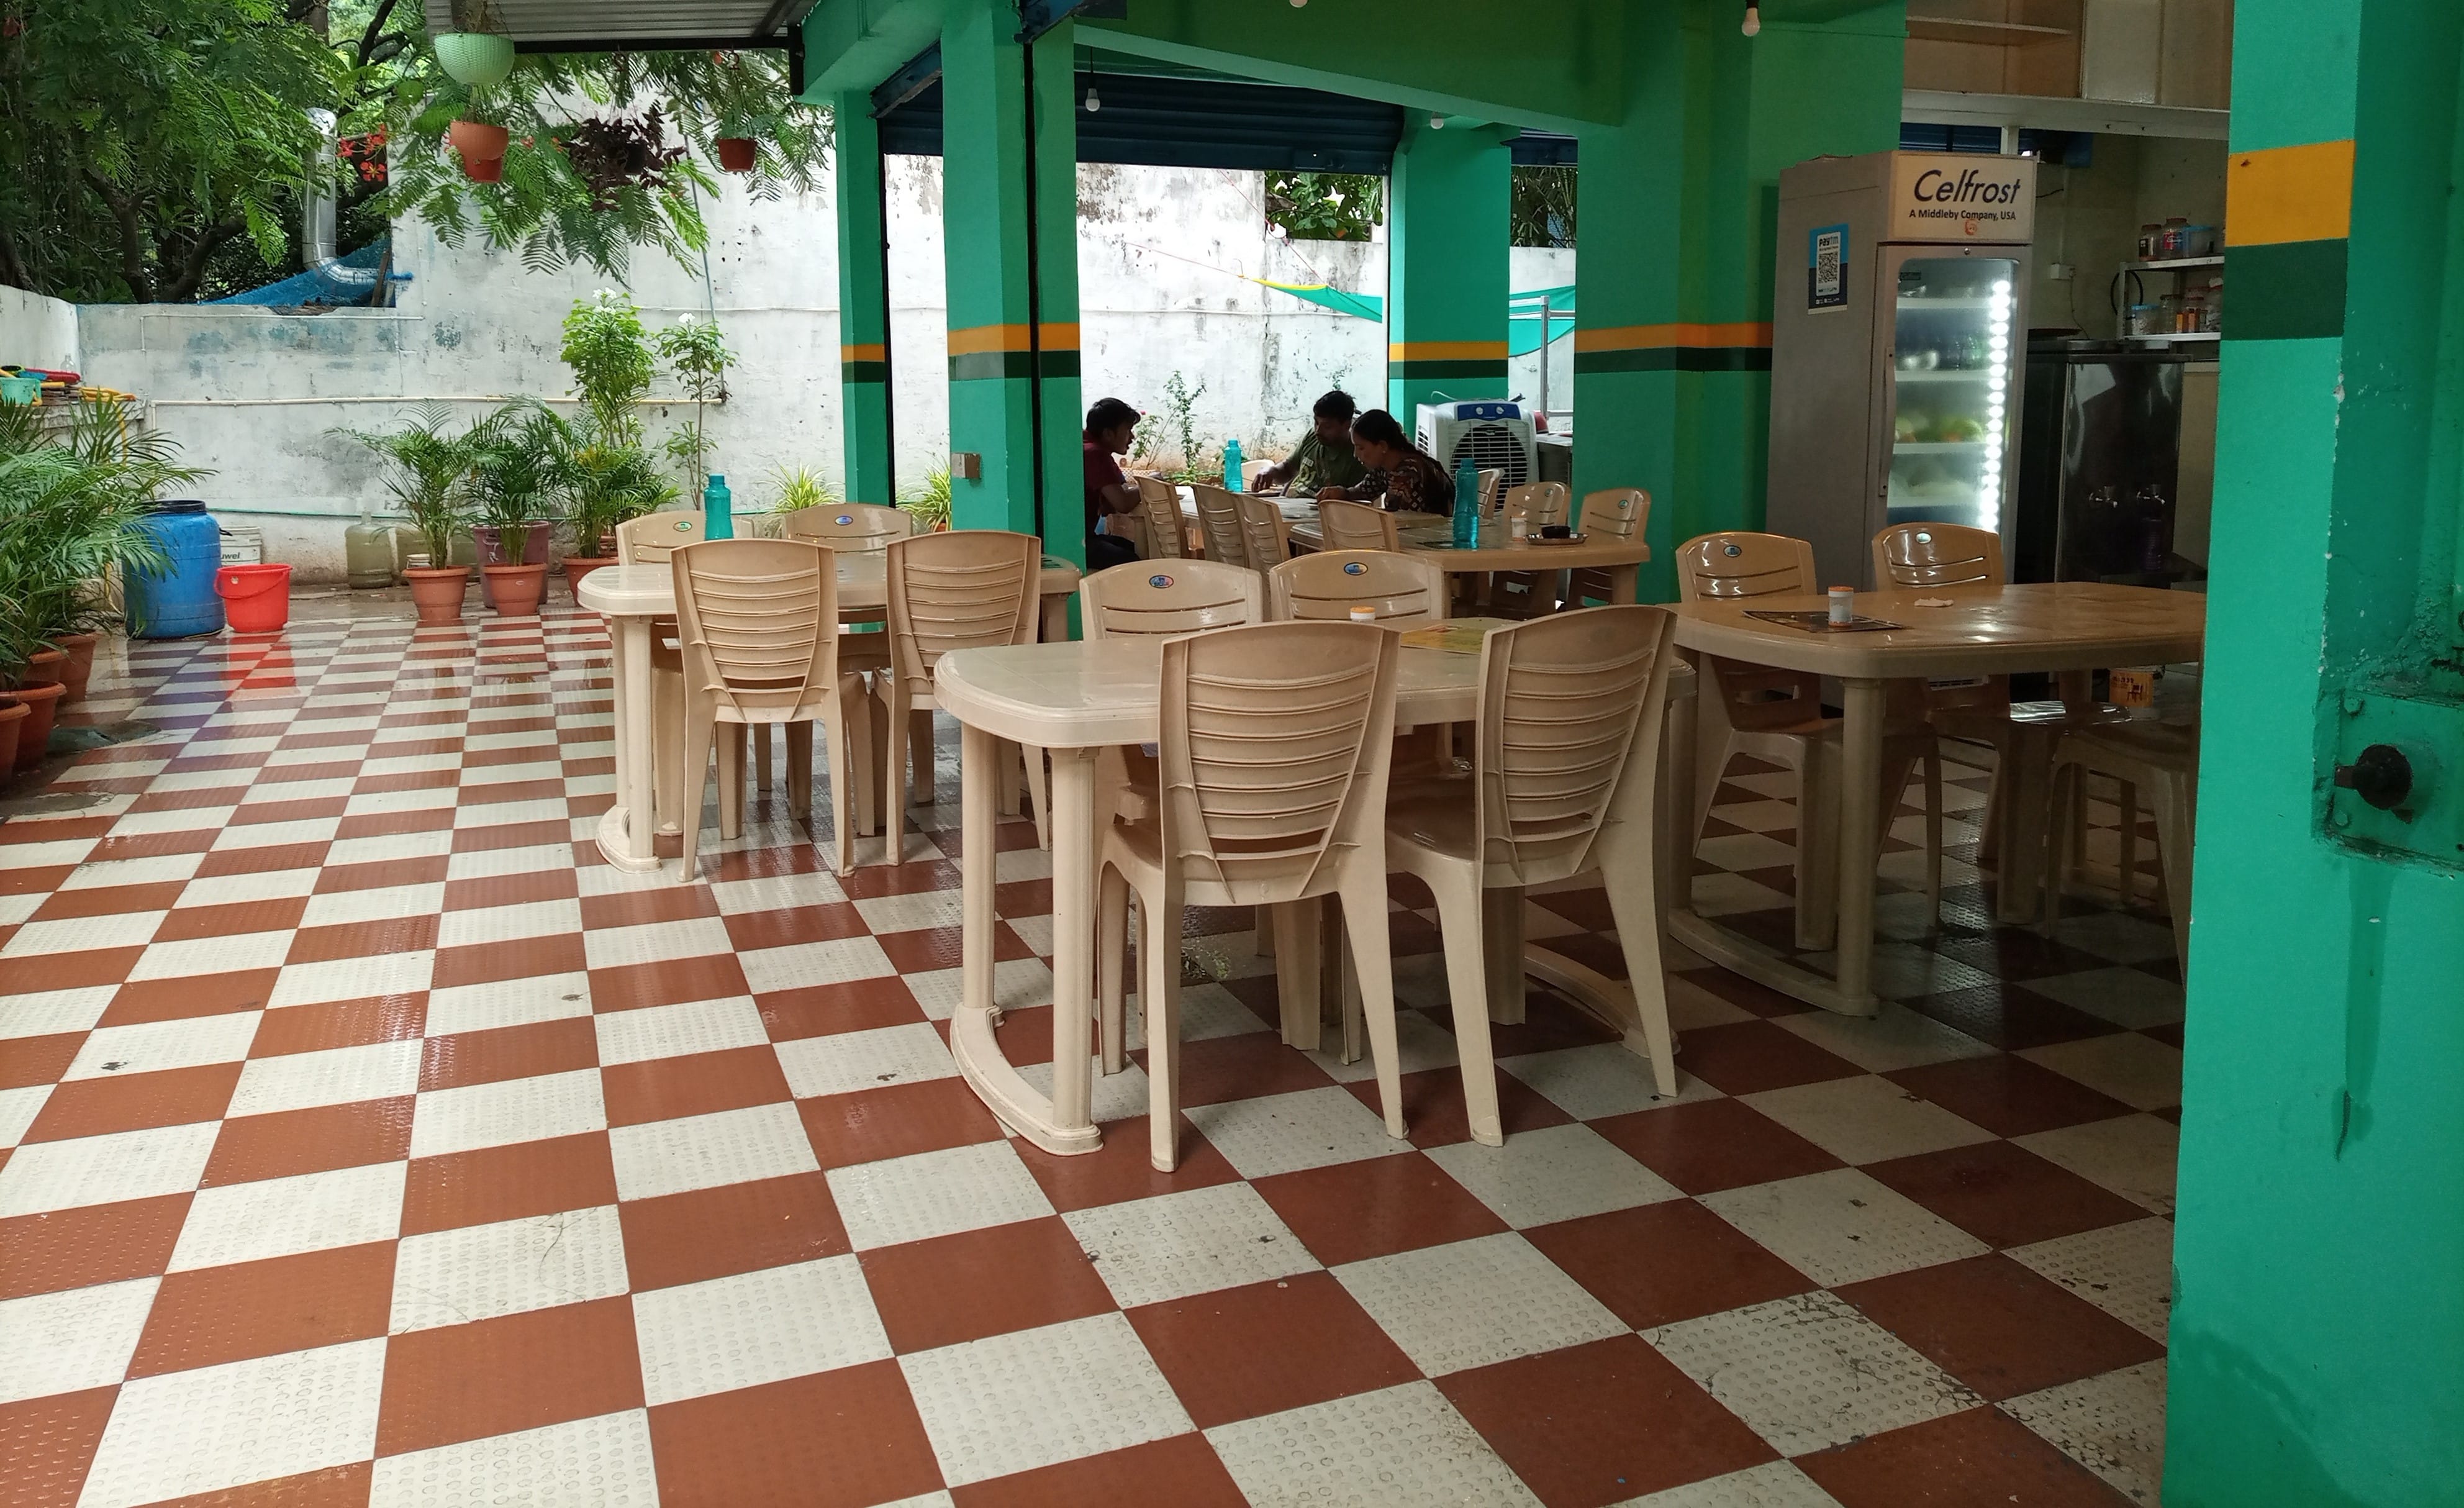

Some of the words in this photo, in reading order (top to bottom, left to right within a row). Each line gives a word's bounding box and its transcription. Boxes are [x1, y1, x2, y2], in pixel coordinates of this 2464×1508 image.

[1914, 169, 2021, 204] Celfrost
[1909, 209, 1916, 217] A
[1919, 209, 1959, 220] Middleby
[1961, 210, 1998, 221] Company,
[2001, 211, 2016, 220] USA
